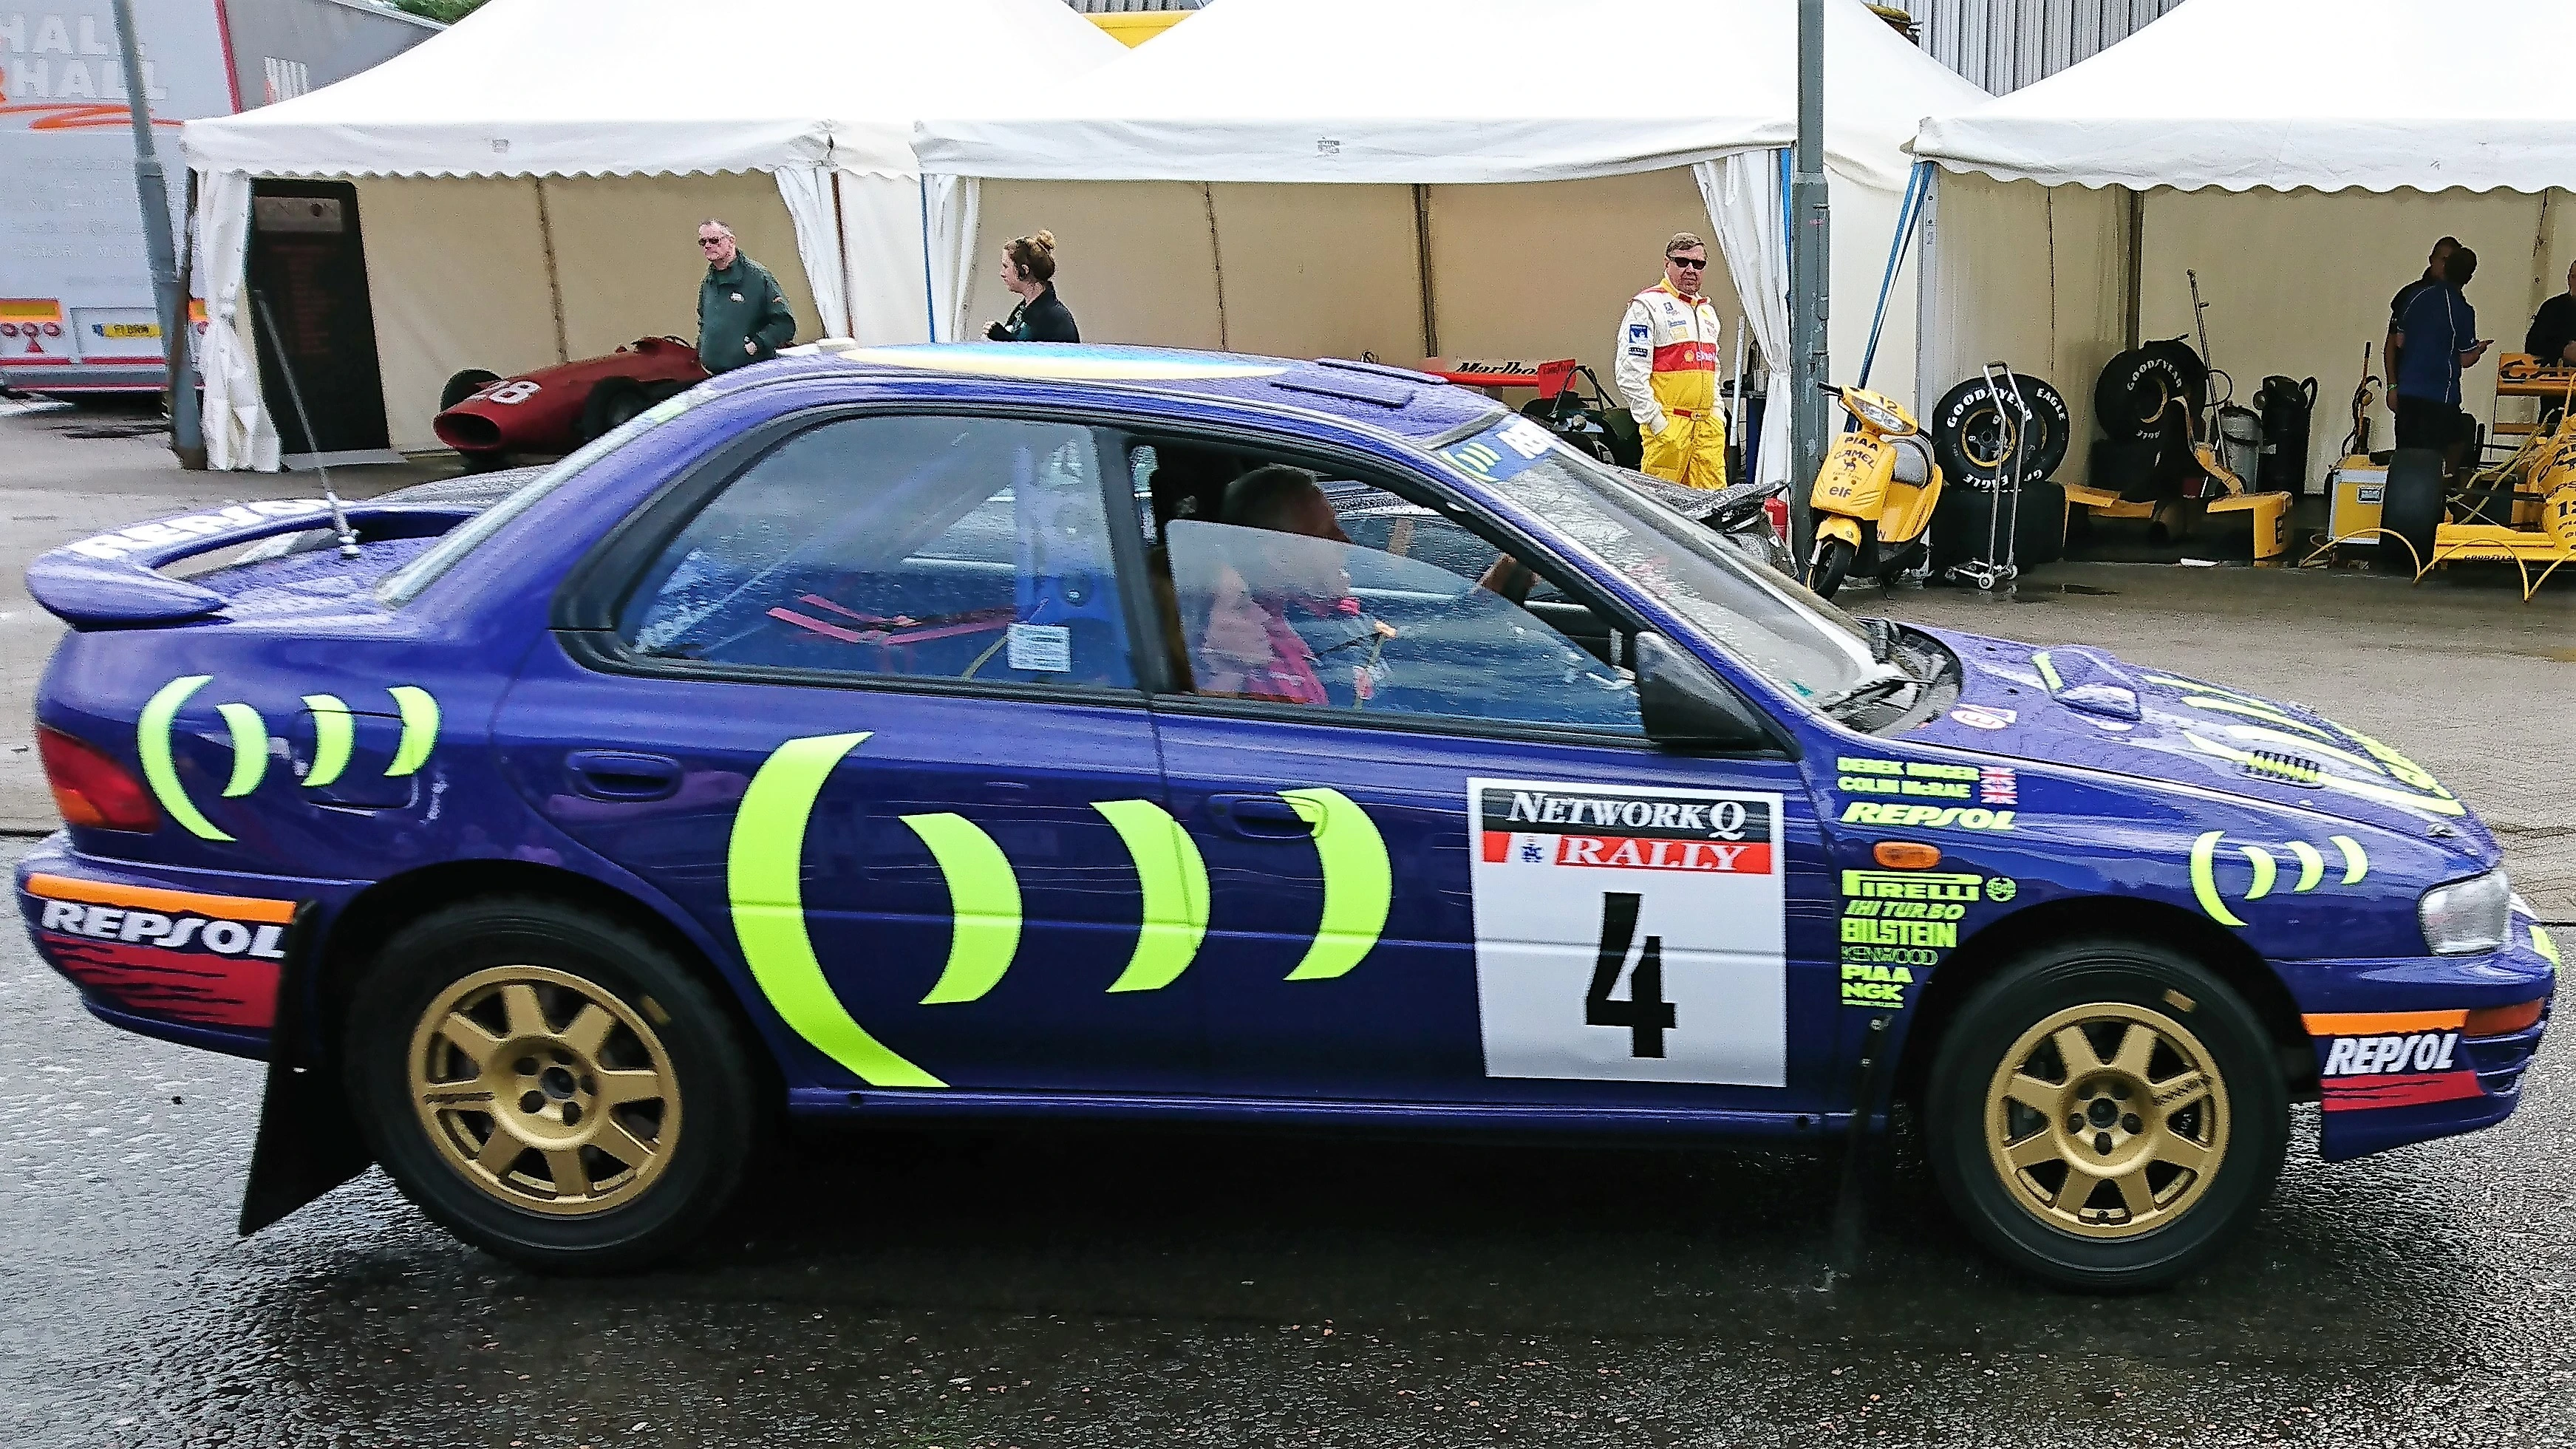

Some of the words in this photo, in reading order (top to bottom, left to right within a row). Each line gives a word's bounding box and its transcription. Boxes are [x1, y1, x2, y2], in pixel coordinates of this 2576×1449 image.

[0, 12, 146, 56] HAL
[1456, 361, 1539, 375] Marlbo
[1696, 350, 1717, 362] Shel
[2127, 358, 2182, 391] GOODYEAR
[1878, 396, 1898, 415] 12
[2036, 387, 2066, 421] EAGLE
[1844, 436, 1878, 451] PIAA
[1834, 449, 1875, 469] CAMEL
[1829, 486, 1853, 498] elf
[1837, 776, 1900, 794] COLIN
[1707, 801, 1747, 840] Q
[1839, 802, 2018, 831] REPSOL
[1561, 838, 1750, 870] RALLY
[1841, 870, 1983, 901] PIRELLI
[1881, 901, 1966, 920] TURBO
[41, 899, 287, 958] REPSOL
[1841, 918, 1957, 948] BILSTEIN
[1841, 945, 1939, 966] KENWOOD
[1585, 891, 1677, 1058] 4
[1841, 964, 1914, 983] PIAA
[1841, 982, 1904, 1001] NGK
[2323, 1033, 2459, 1076] REPSOL
